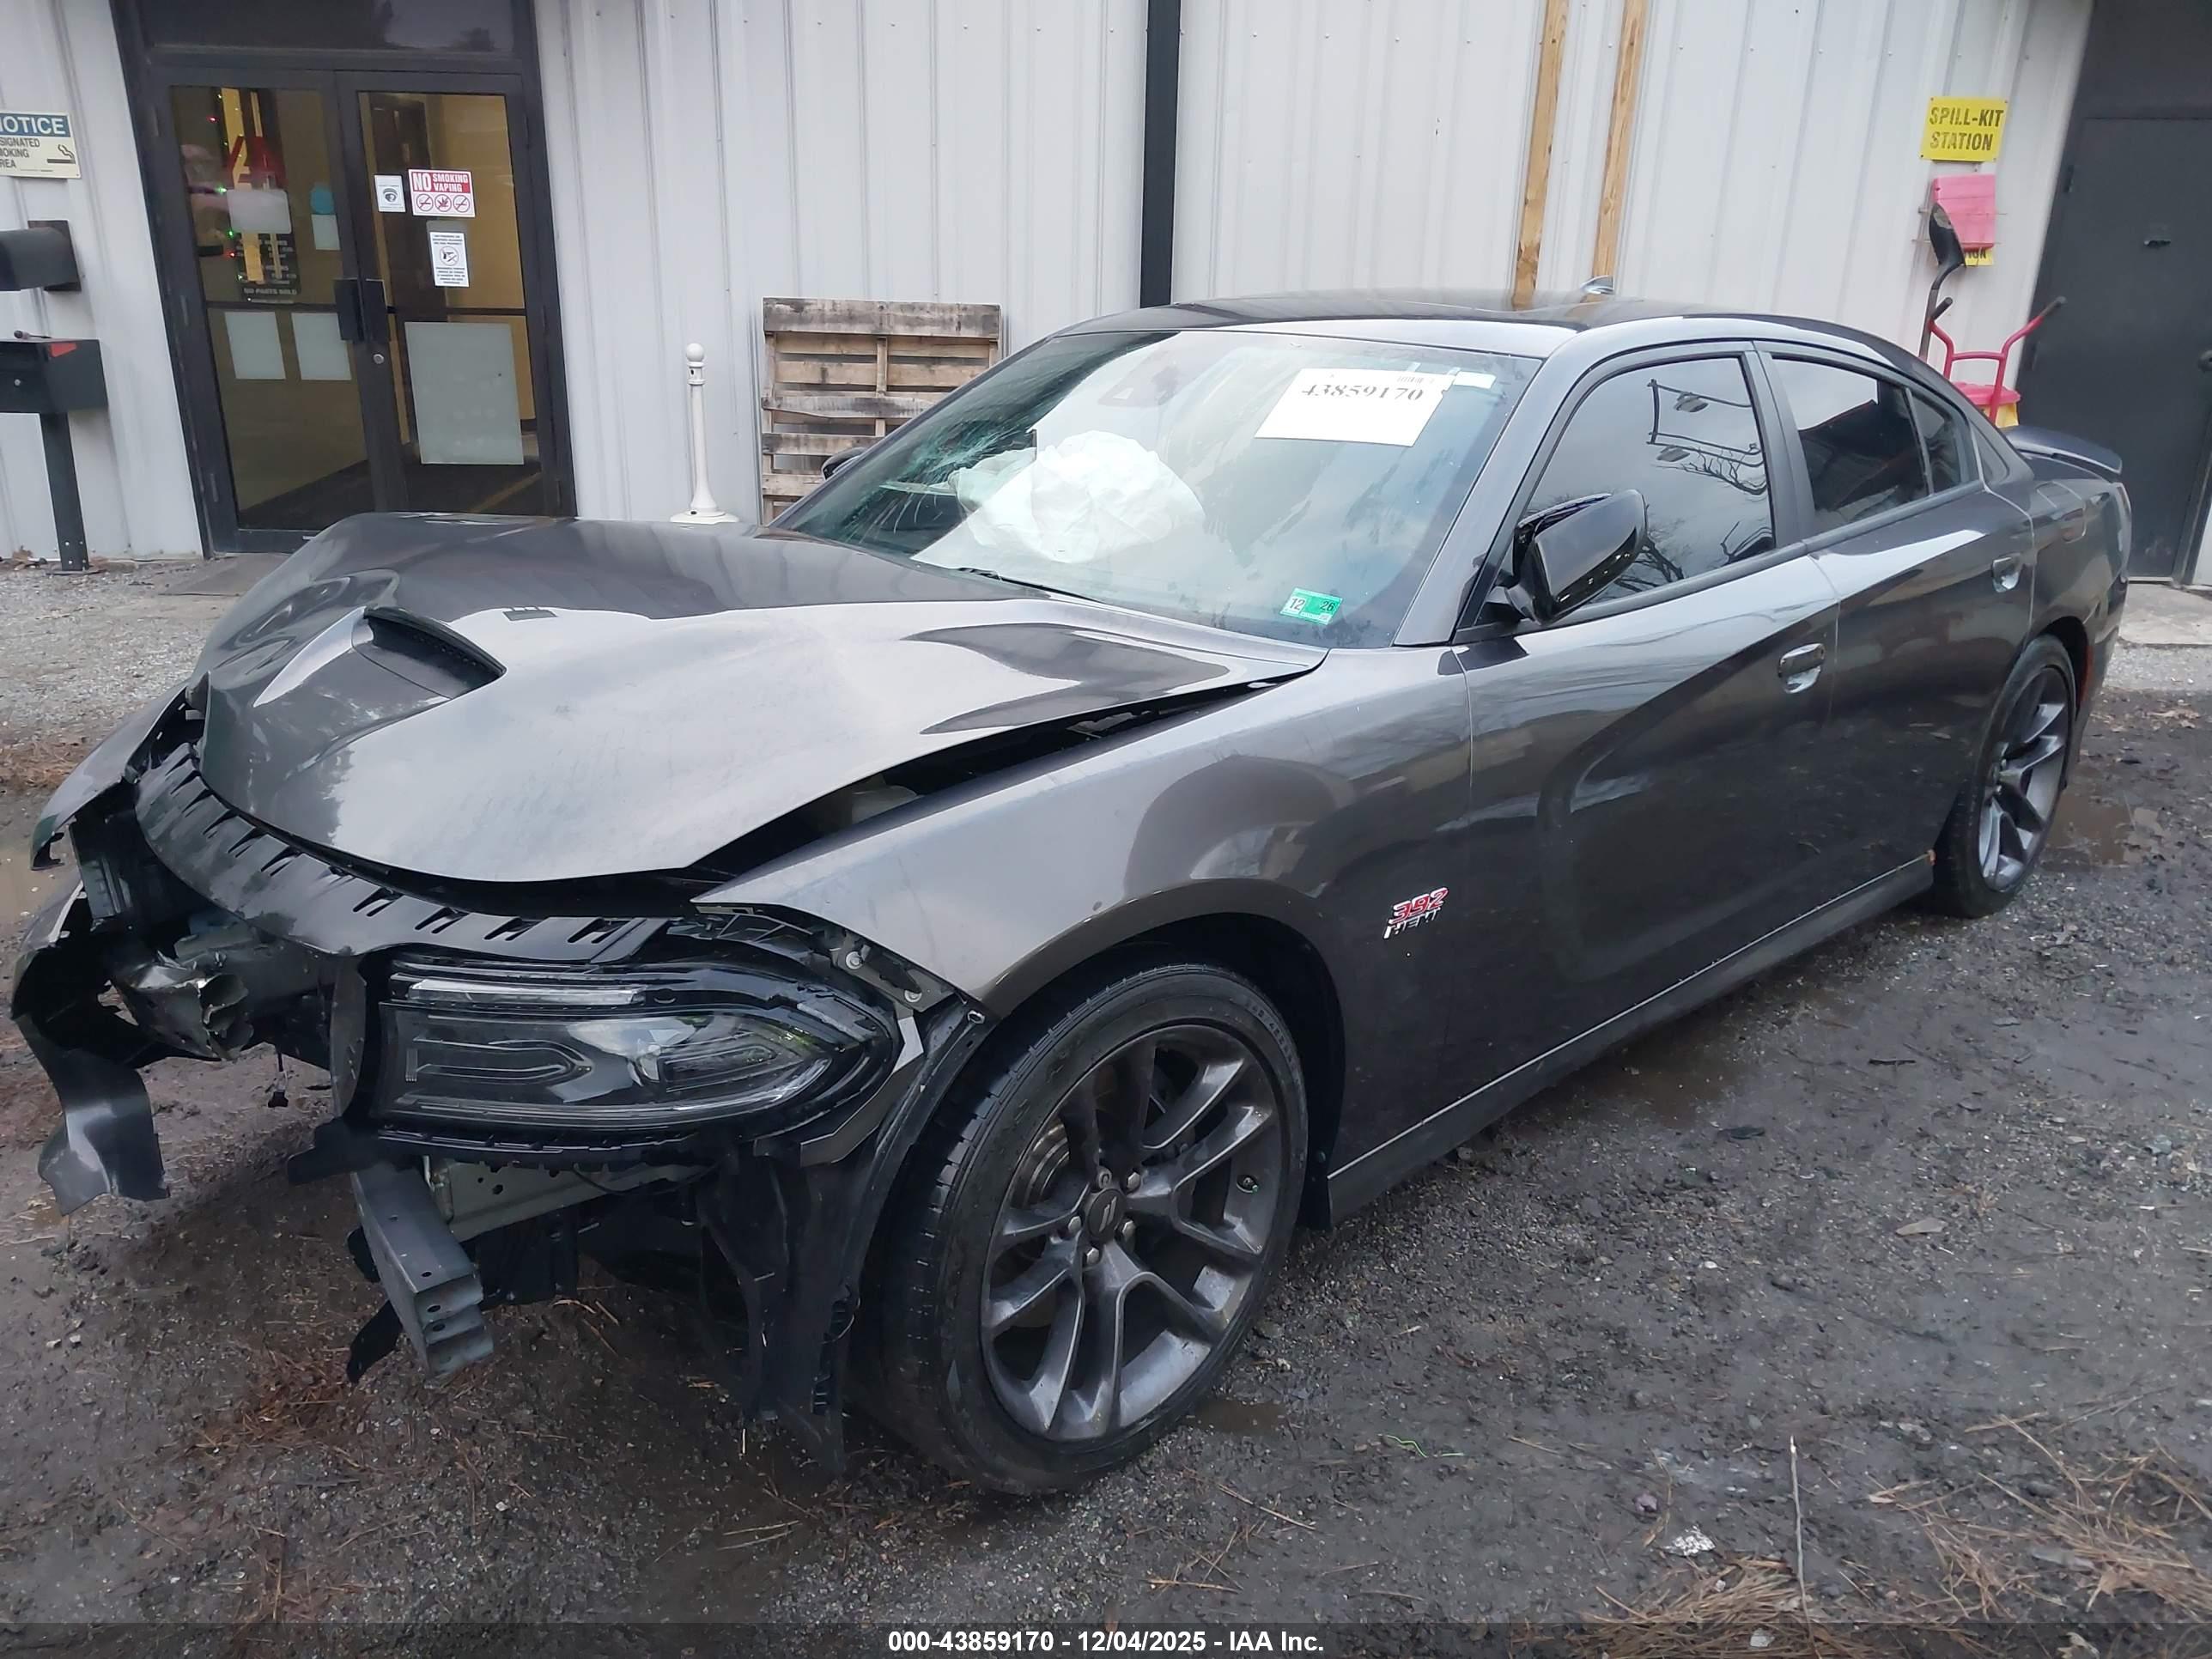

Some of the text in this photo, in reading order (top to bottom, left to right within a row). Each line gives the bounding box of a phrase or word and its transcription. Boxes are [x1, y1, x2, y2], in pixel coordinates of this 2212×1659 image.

[0, 116, 66, 134] OTICE
[1929, 107, 2004, 128] SPILL-KIT
[1930, 131, 1994, 151] STATION
[412, 173, 432, 191] NO
[432, 173, 469, 184] SMOKING
[433, 183, 463, 192] VAPING
[1302, 384, 1424, 401] 43859170
[1290, 598, 1335, 611] 12 26
[1388, 887, 1449, 925] 392
